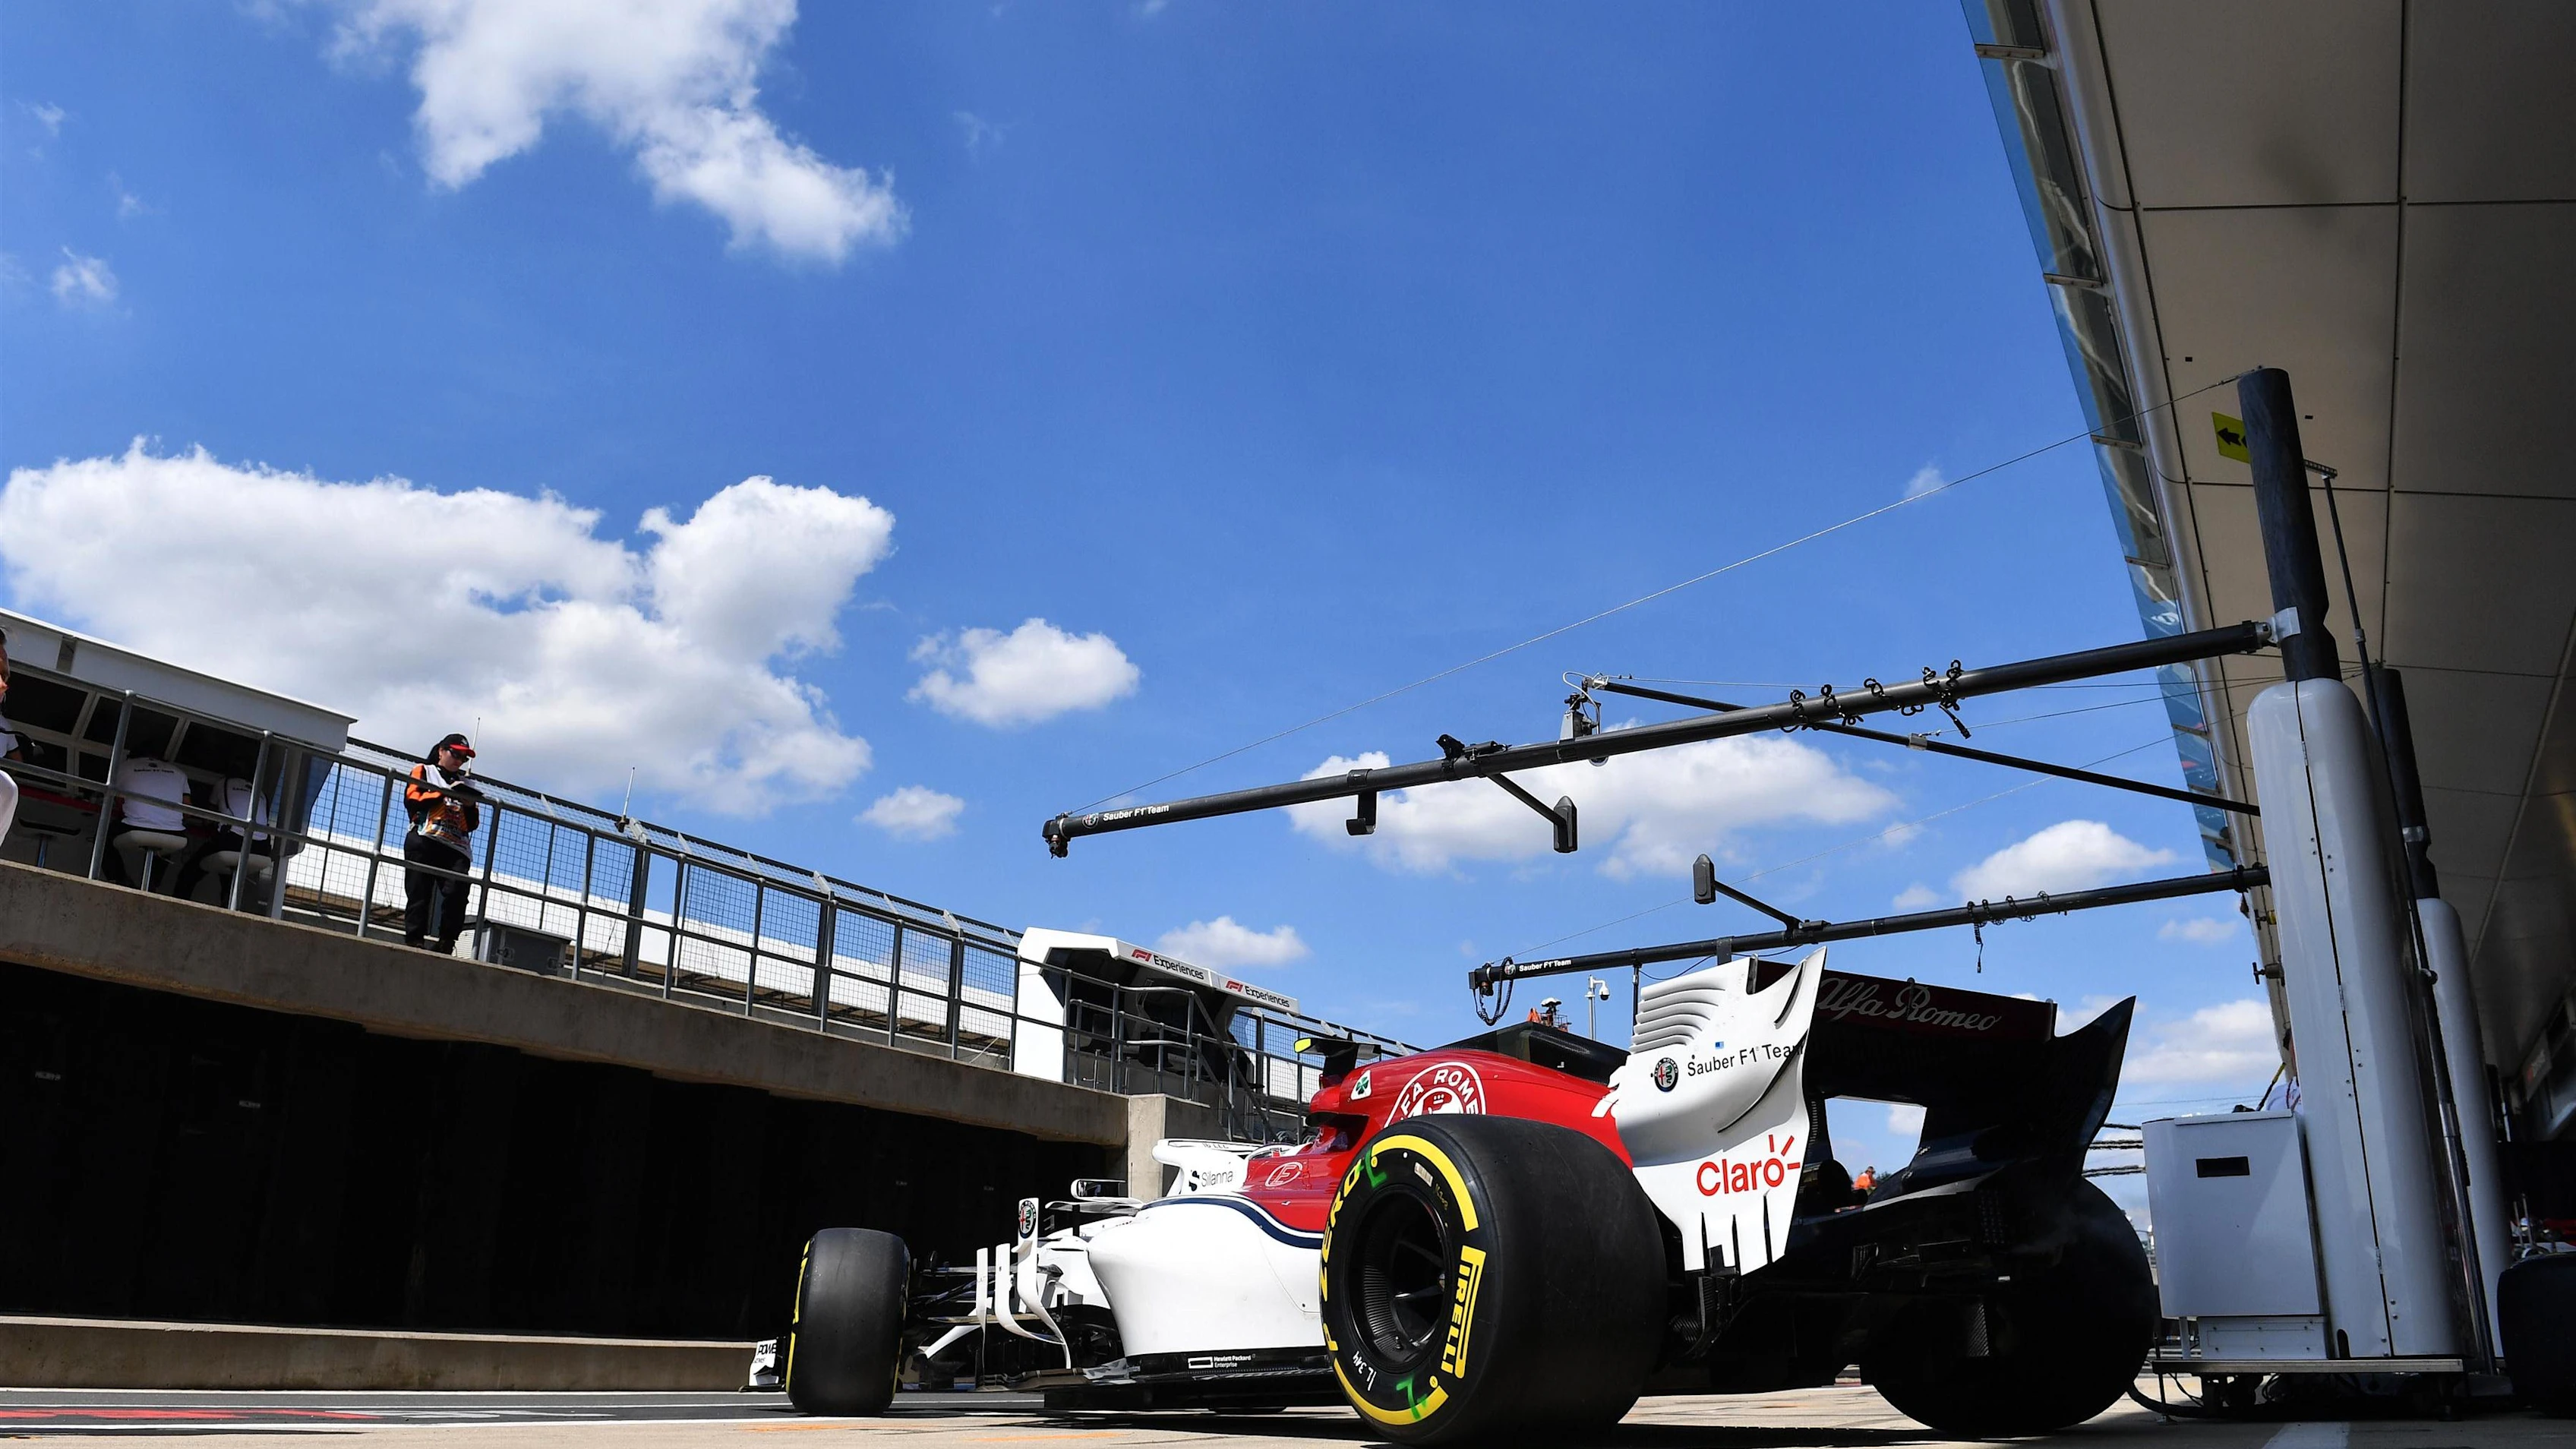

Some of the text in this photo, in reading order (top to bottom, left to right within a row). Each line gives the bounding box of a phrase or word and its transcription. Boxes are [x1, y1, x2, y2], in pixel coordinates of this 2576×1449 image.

[1103, 810, 1133, 822] Sauber
[1148, 805, 1170, 815] Team
[1131, 949, 1204, 980] F1 Experiences
[1519, 963, 1542, 972] Sauber
[1225, 980, 1290, 1008] F1 Experiences
[1817, 977, 2002, 1031] Alfa Romeo
[1687, 1056, 1735, 1077] Sauber
[1739, 1047, 1757, 1065] F1
[1433, 1069, 1479, 1115] ROME
[1201, 1170, 1233, 1187] Silanna
[1697, 1157, 1785, 1197] Claro
[1441, 1245, 1487, 1379] PIRELLI
